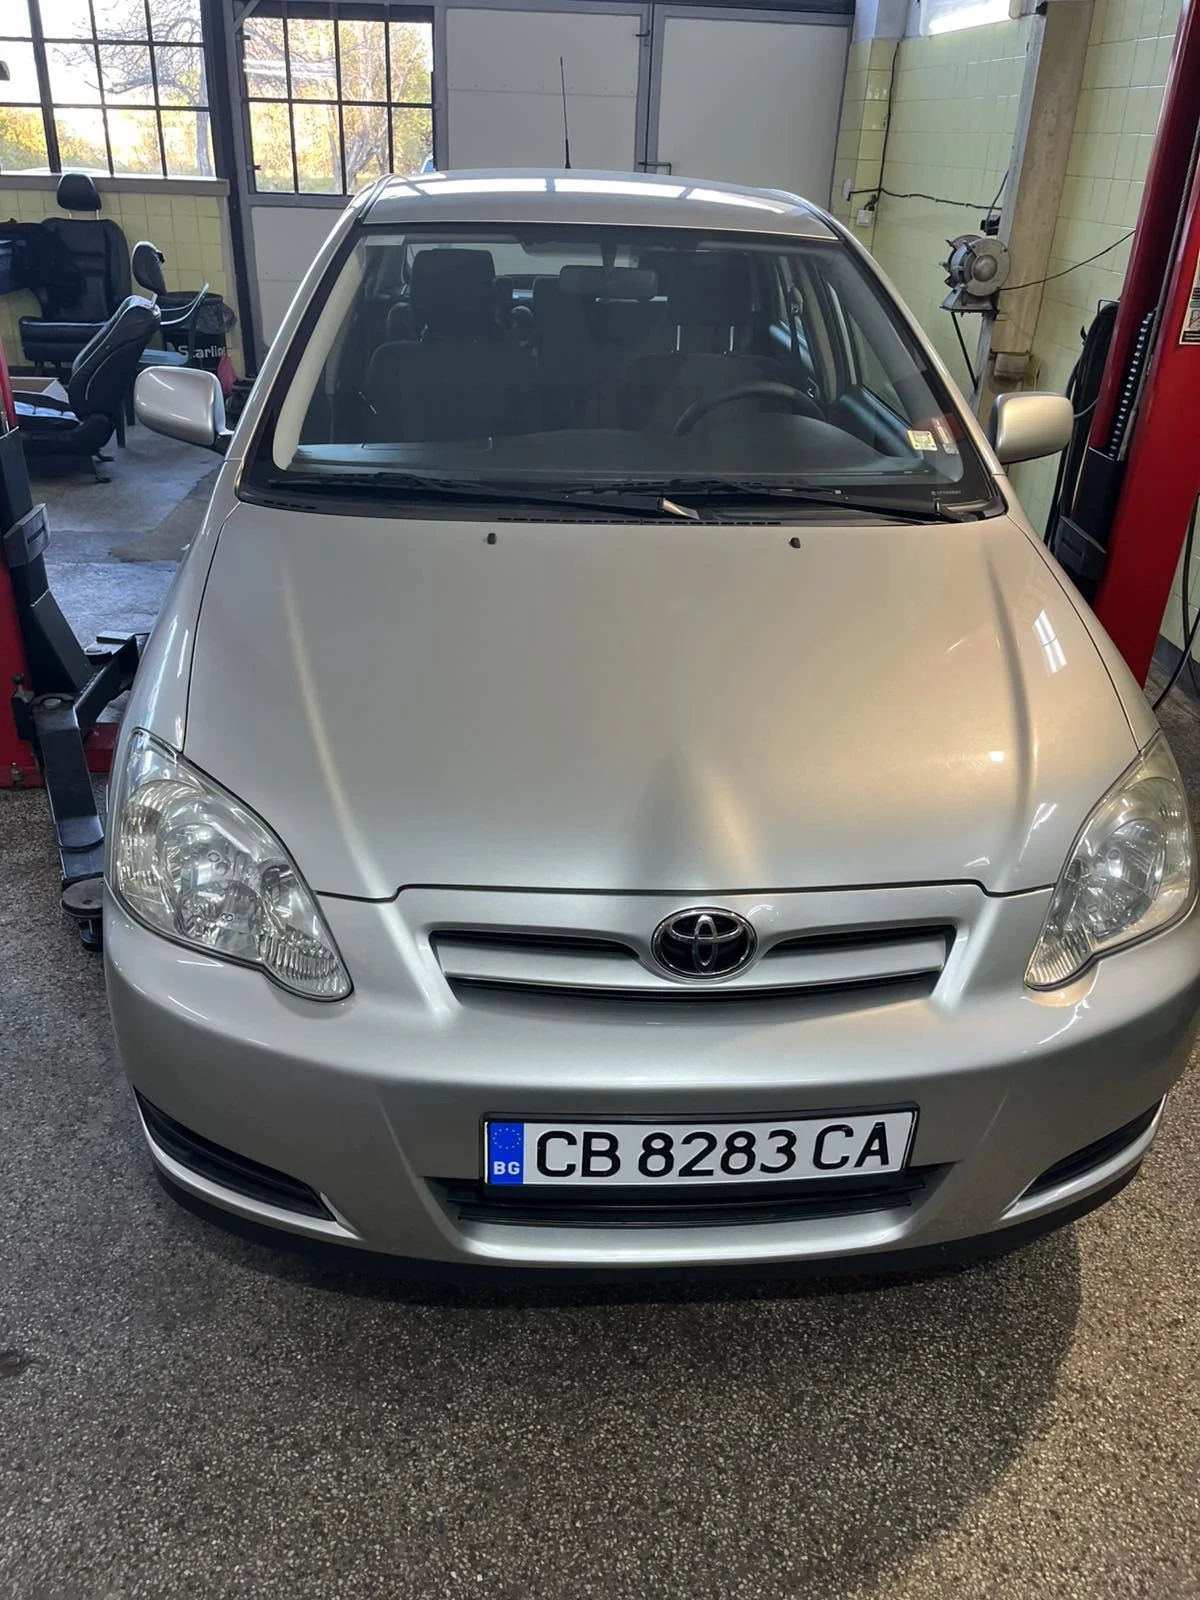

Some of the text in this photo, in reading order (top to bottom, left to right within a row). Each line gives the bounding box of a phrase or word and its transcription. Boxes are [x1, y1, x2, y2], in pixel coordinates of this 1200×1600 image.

[537, 1121, 889, 1177] CB 8283 CA
[494, 1161, 520, 1175] BG
